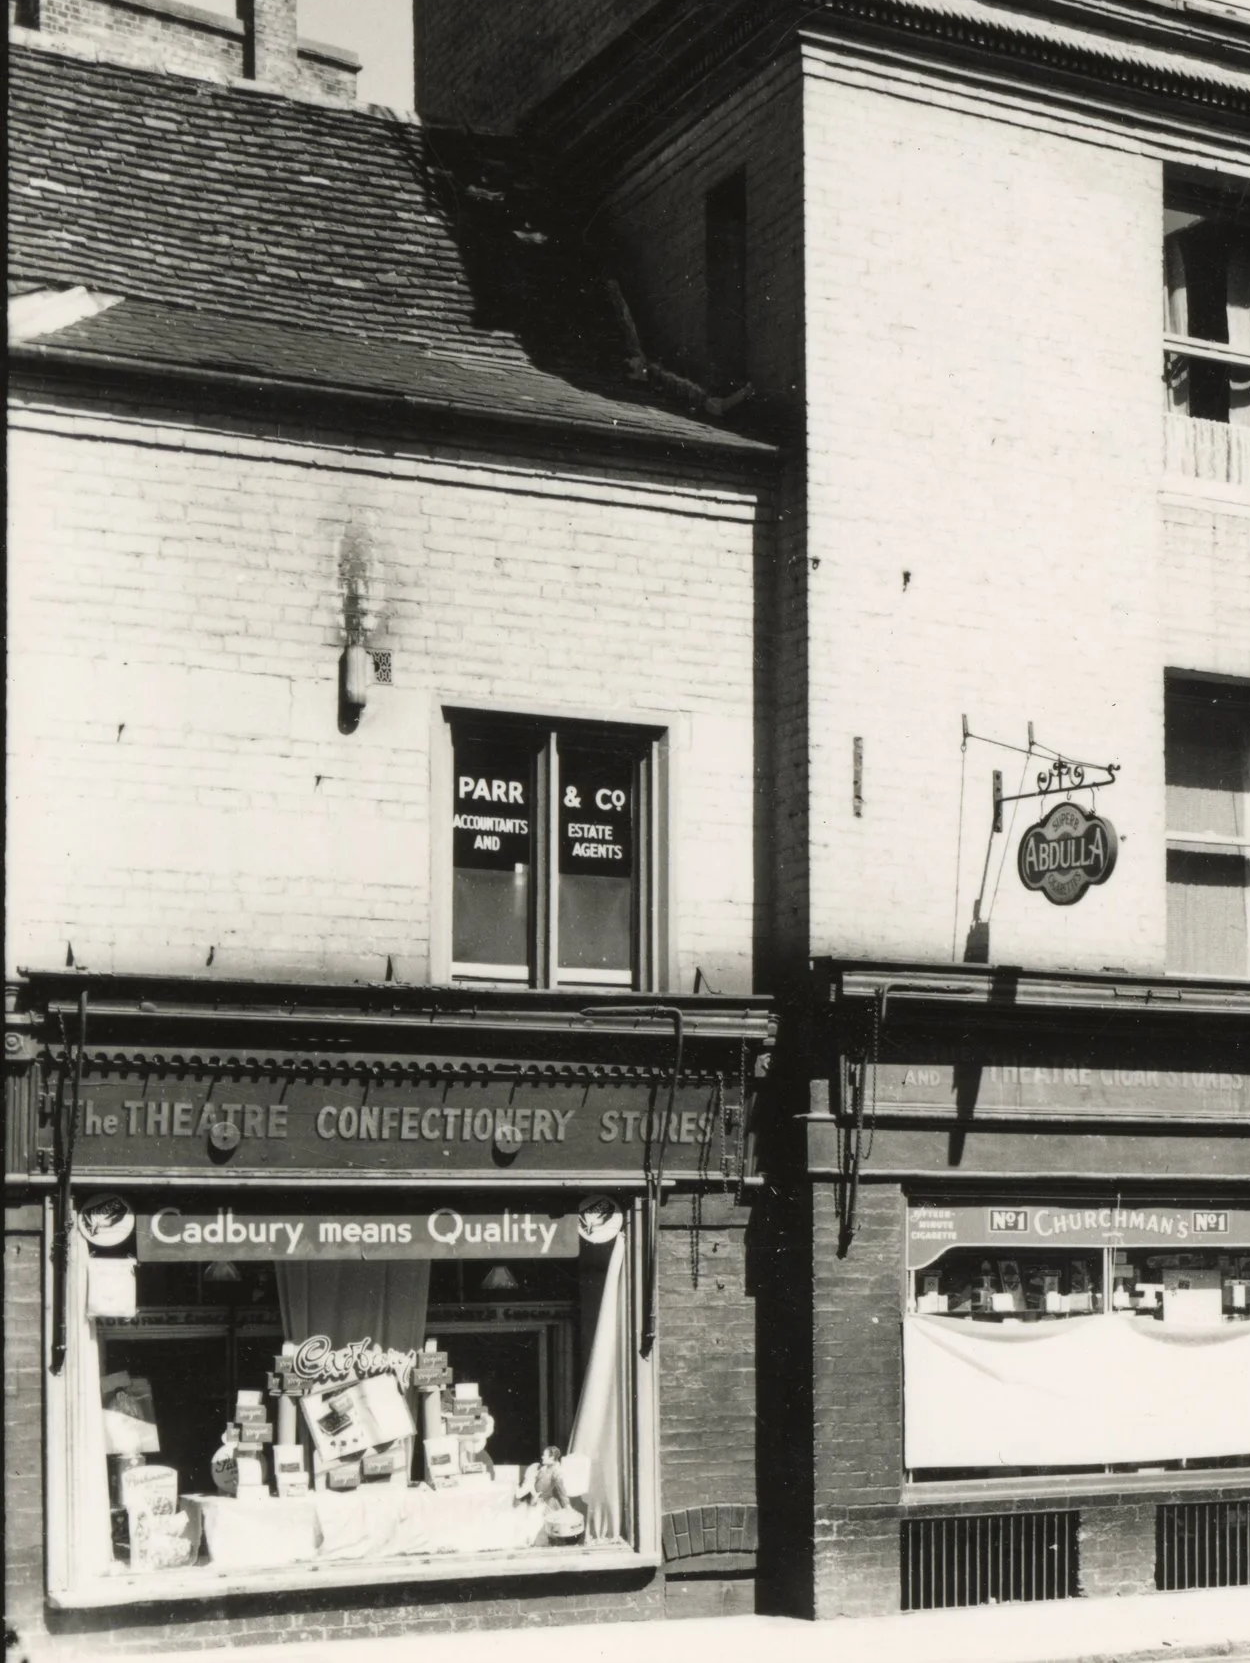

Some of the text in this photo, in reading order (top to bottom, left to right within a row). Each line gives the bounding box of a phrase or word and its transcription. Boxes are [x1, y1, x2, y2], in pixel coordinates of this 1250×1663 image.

[458, 775, 525, 804] PARR
[563, 785, 582, 808] &
[453, 813, 529, 835] ACCOUNTANTS
[567, 822, 613, 840] ESTATE
[473, 834, 501, 851] AND
[571, 841, 623, 860] AGENTS
[1025, 826, 1105, 877] ABDULLA
[903, 1069, 941, 1086] AND
[122, 1100, 289, 1139] THEATRE
[317, 1105, 577, 1143] CONFECTIONERY
[150, 1206, 559, 1255] Cadbury means Quality
[910, 1231, 957, 1240] CIGARETTE
[293, 1334, 417, 1389] Cadbury
